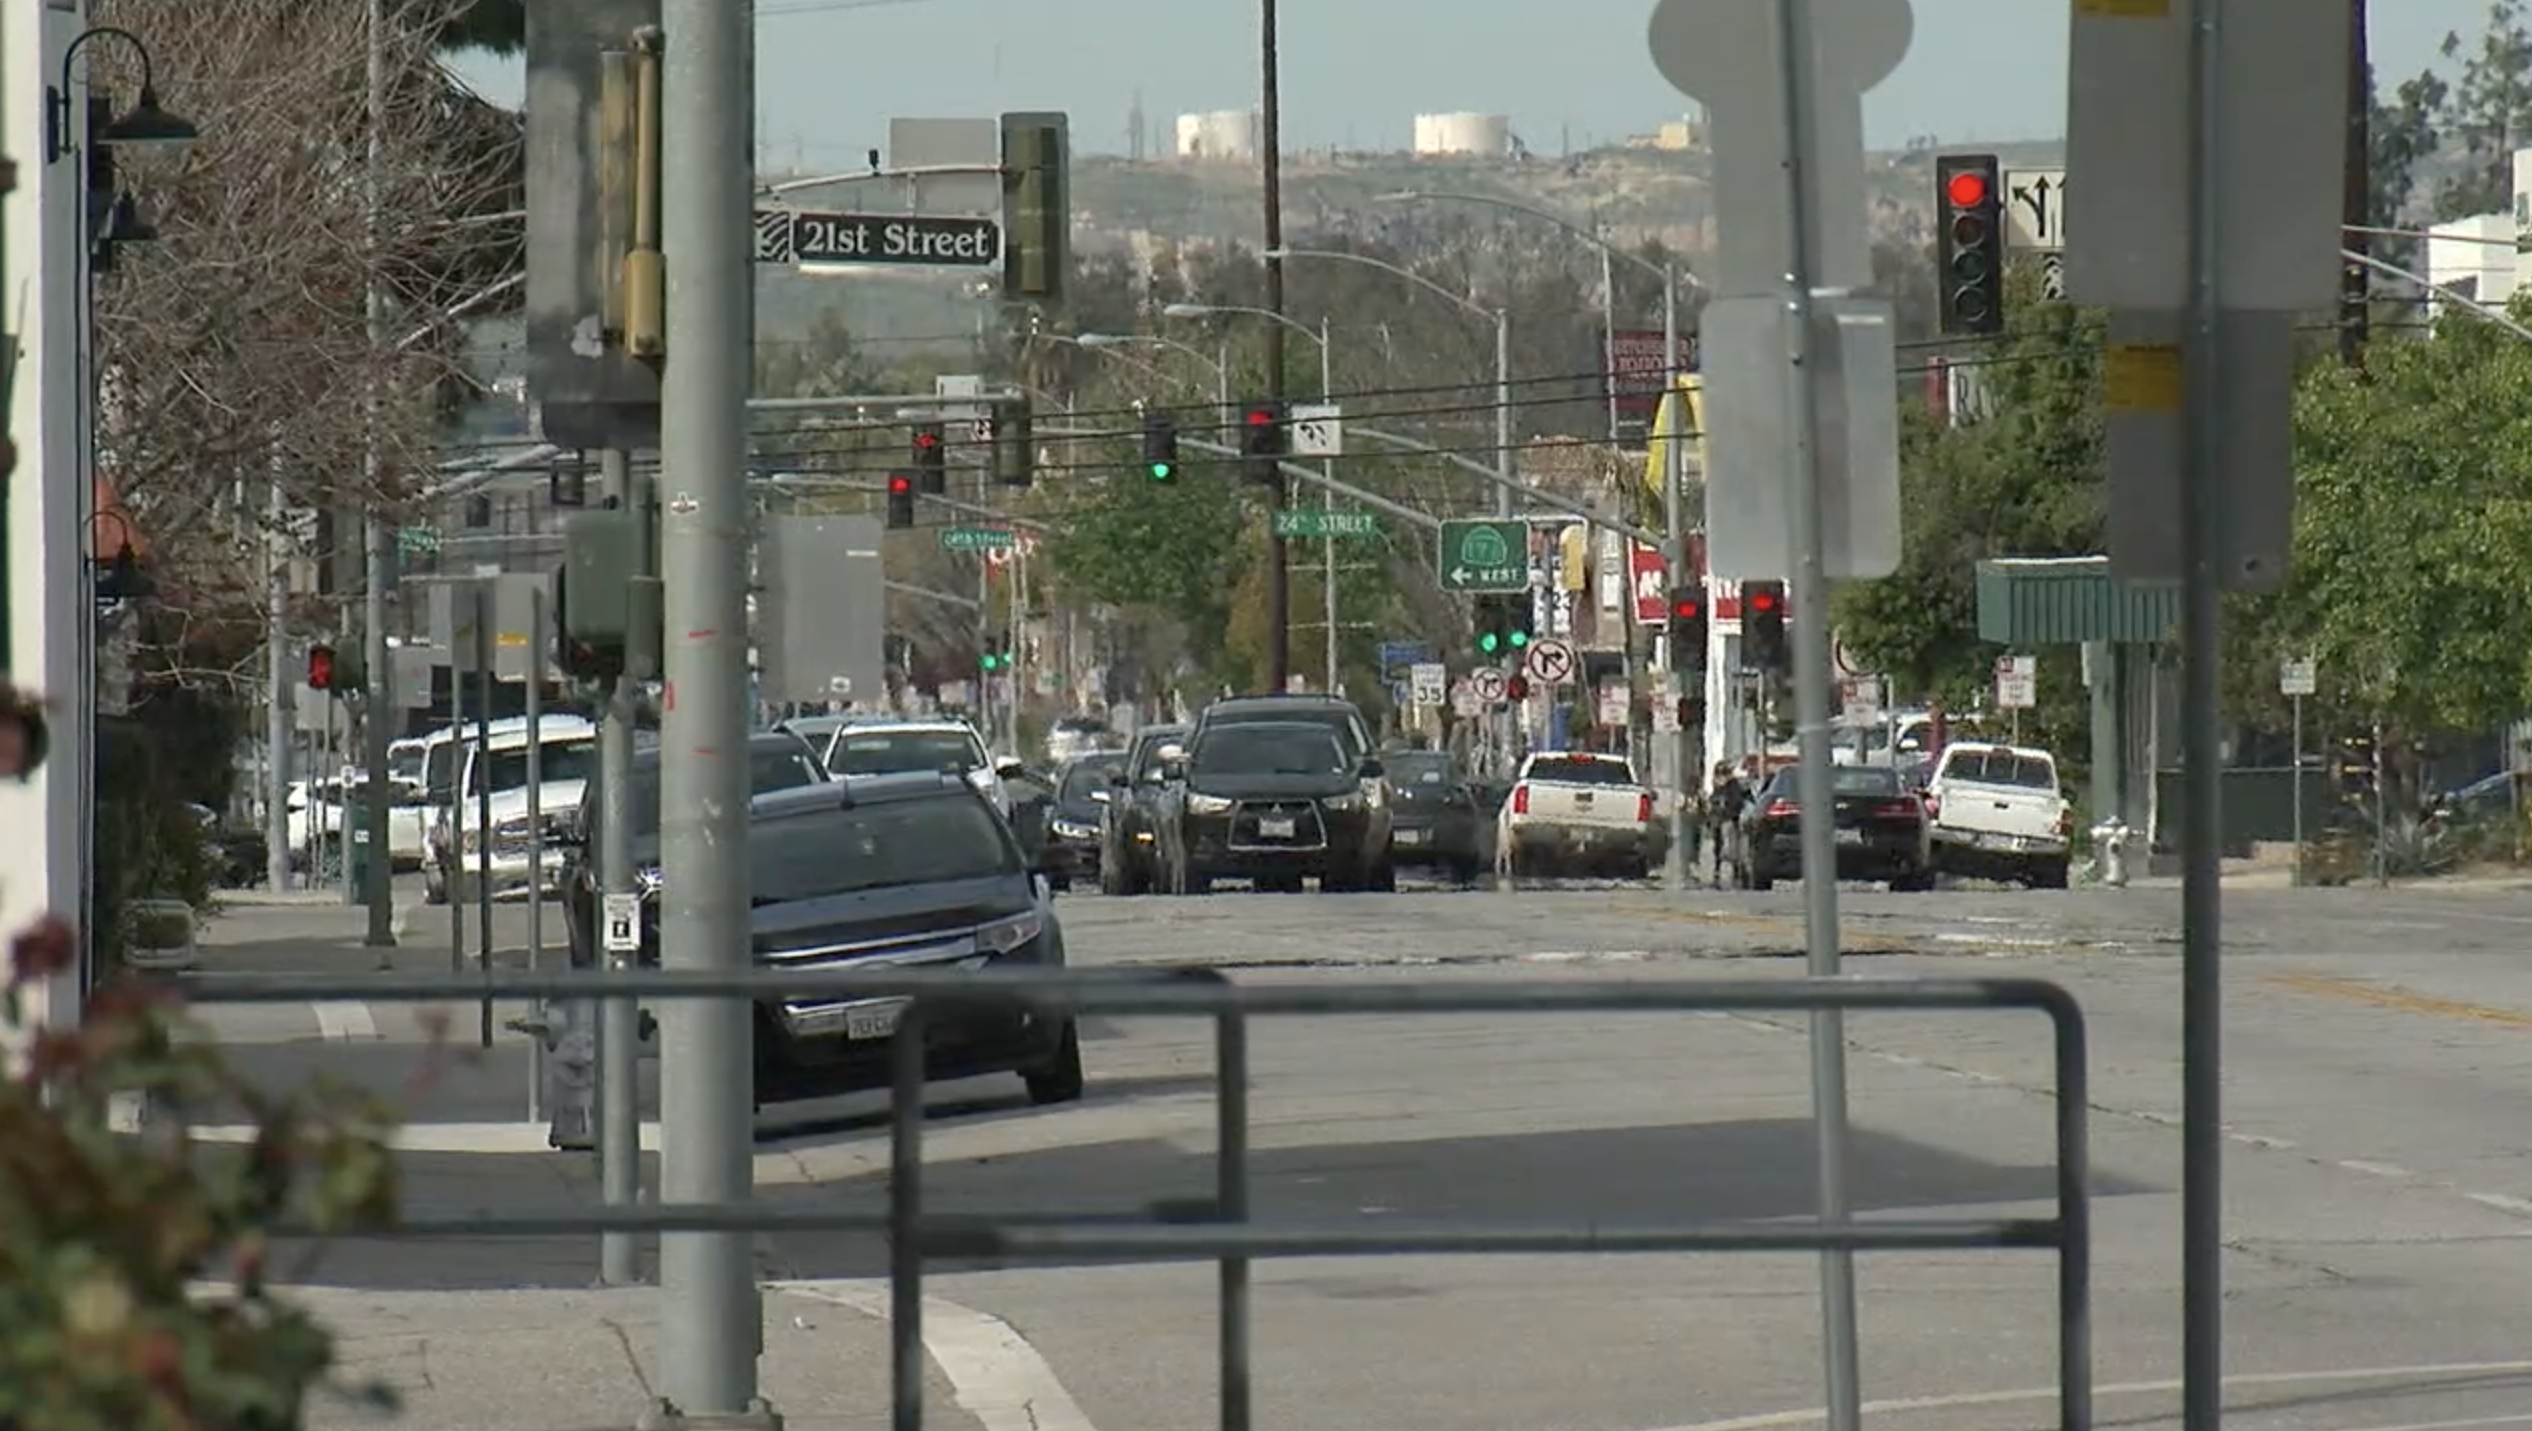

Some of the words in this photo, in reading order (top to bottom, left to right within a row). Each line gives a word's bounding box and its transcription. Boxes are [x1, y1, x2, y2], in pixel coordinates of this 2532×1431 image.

[804, 221, 869, 254] 21st
[883, 223, 989, 257] Street
[1317, 515, 1373, 533] STREET
[1479, 568, 1518, 582] WEST
[1417, 686, 1442, 702] 35
